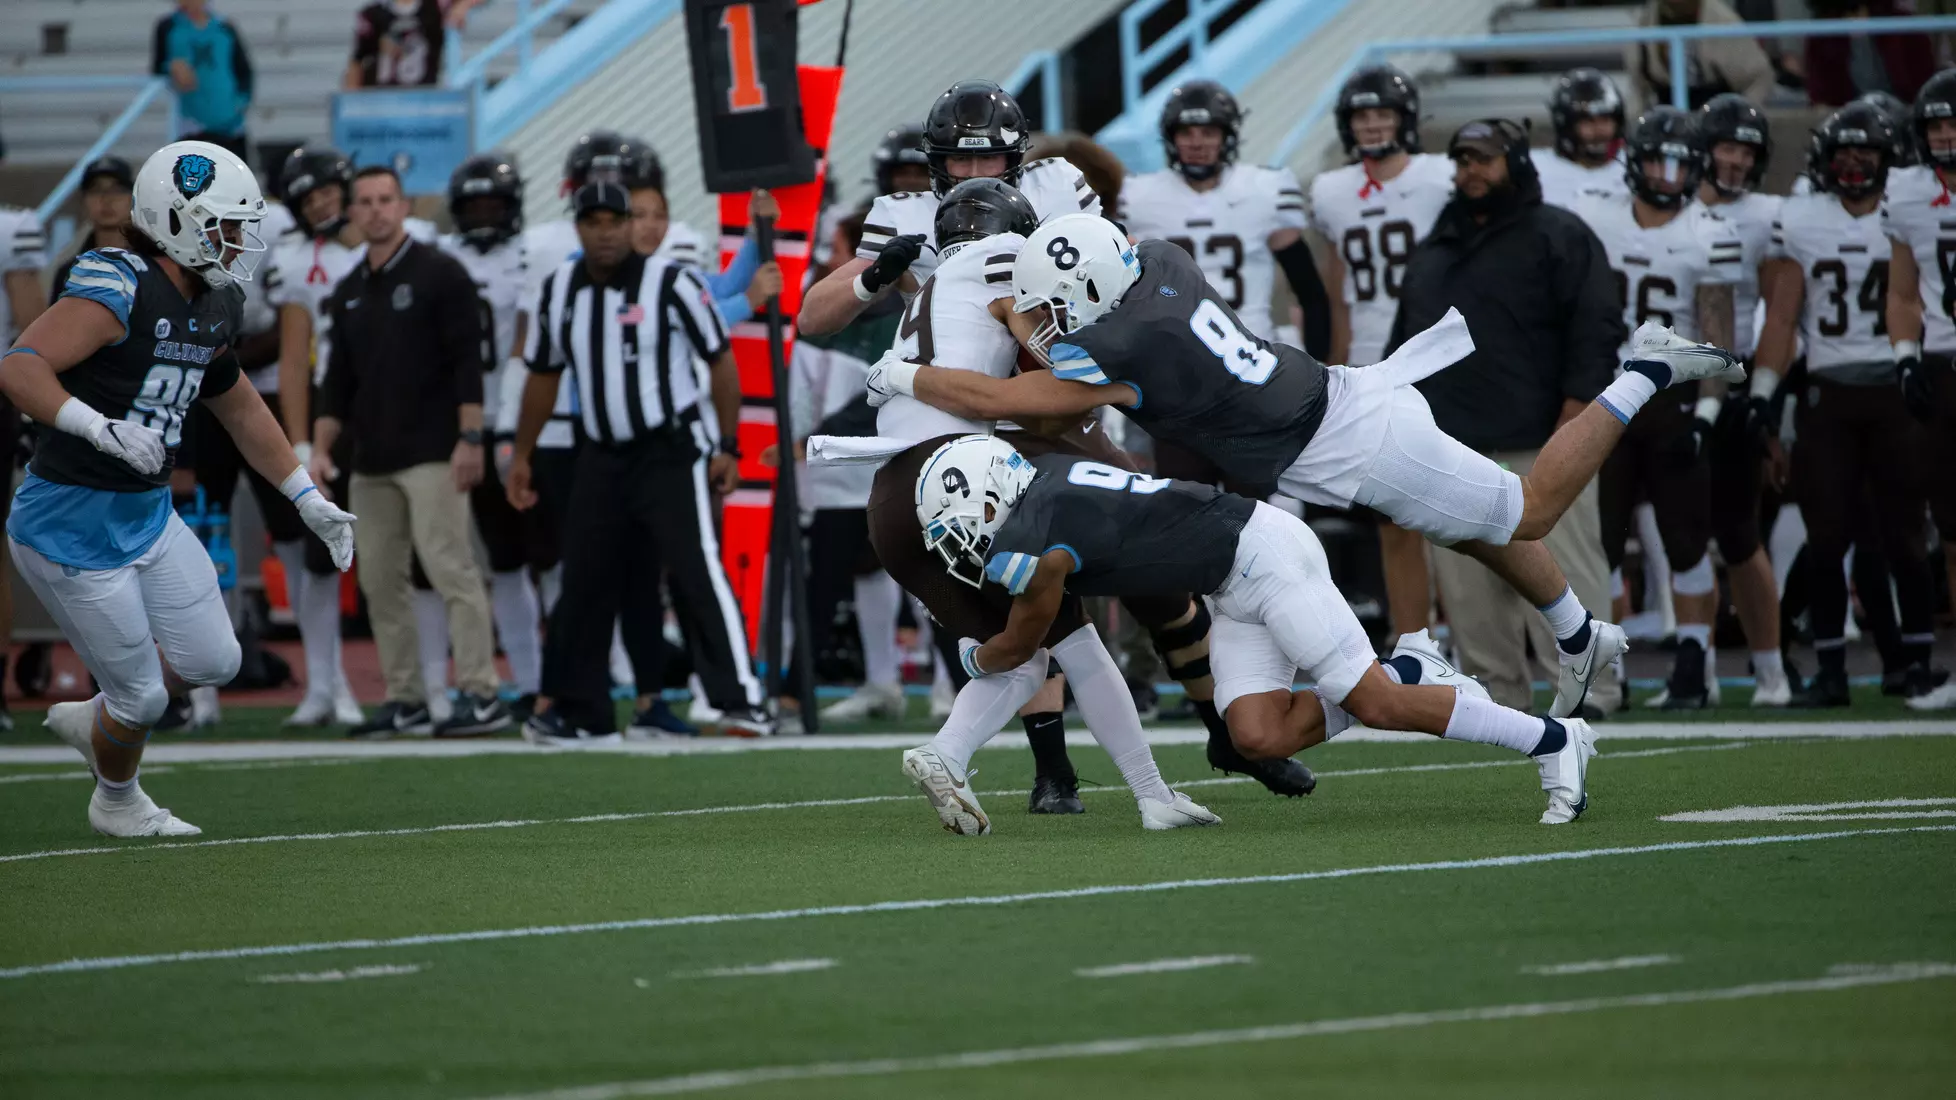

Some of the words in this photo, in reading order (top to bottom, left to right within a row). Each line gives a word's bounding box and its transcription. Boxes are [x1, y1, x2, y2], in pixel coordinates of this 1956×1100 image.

[718, 3, 769, 113] 1
[1046, 236, 1081, 271] 8
[1344, 220, 1416, 303] 88
[1812, 258, 1890, 337] 34
[1190, 299, 1278, 385] 8
[941, 466, 971, 499] 9
